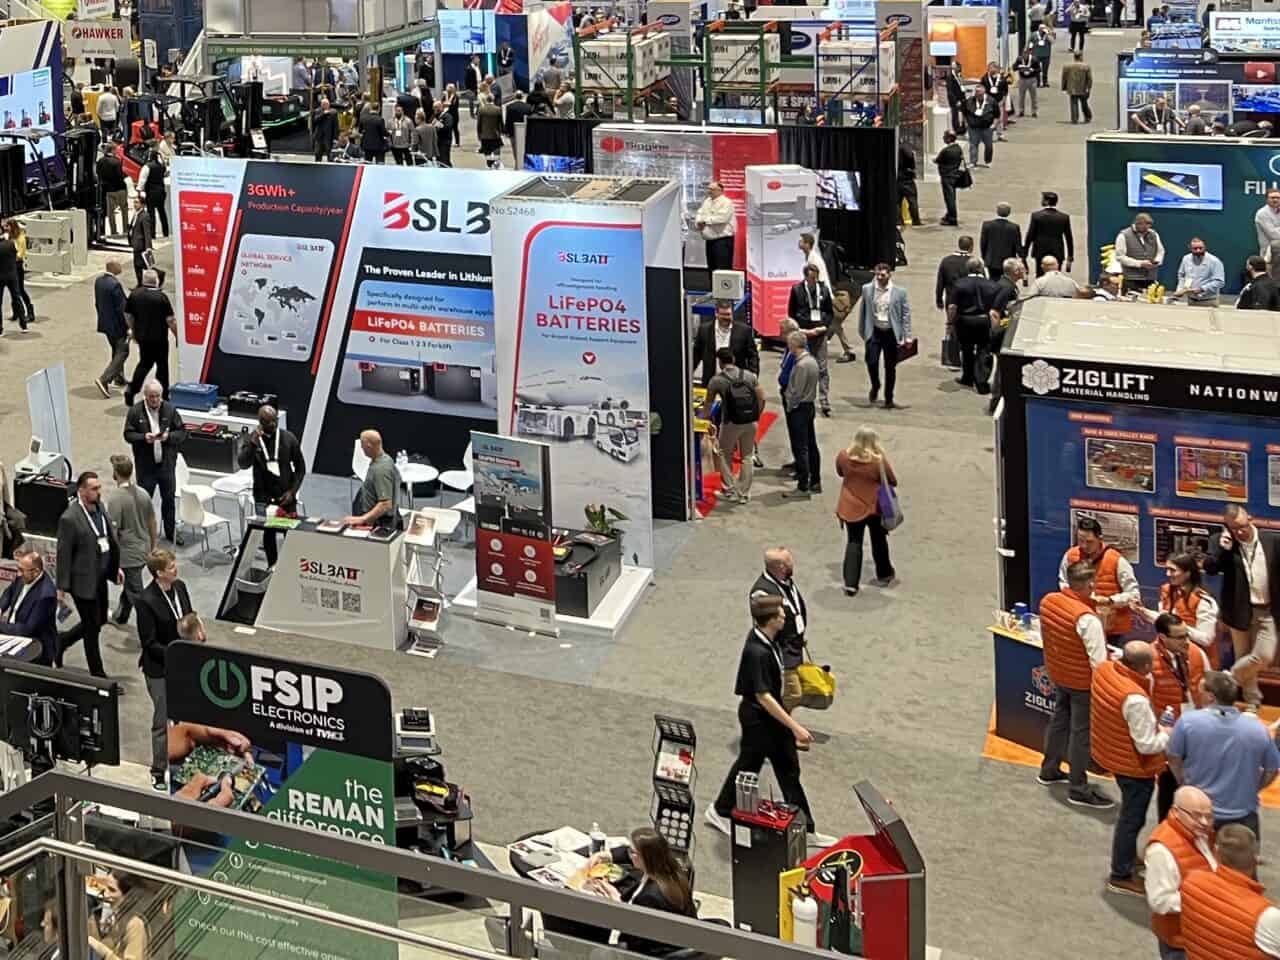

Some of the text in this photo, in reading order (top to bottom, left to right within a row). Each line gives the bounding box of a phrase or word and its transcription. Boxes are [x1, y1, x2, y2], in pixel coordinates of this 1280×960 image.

[82, 27, 124, 39] HAWKER
[247, 183, 297, 198] 3GWh+
[363, 264, 380, 275] The
[382, 266, 414, 278] Proven
[415, 268, 446, 280] Leader
[548, 294, 627, 313] LiFePO4
[367, 316, 485, 337] LiFePO4 BATTERIES
[536, 312, 641, 334] BATTERIES
[1062, 367, 1279, 402] ZIGLIFT NATIONW
[1062, 387, 1150, 402] MATERIAL HANDLING
[249, 665, 344, 713] FSIP
[252, 702, 345, 731] ELECTRONICS
[344, 778, 383, 804] the
[288, 788, 385, 830] REMAN
[188, 917, 217, 934] Check
[276, 939, 319, 959] effective
